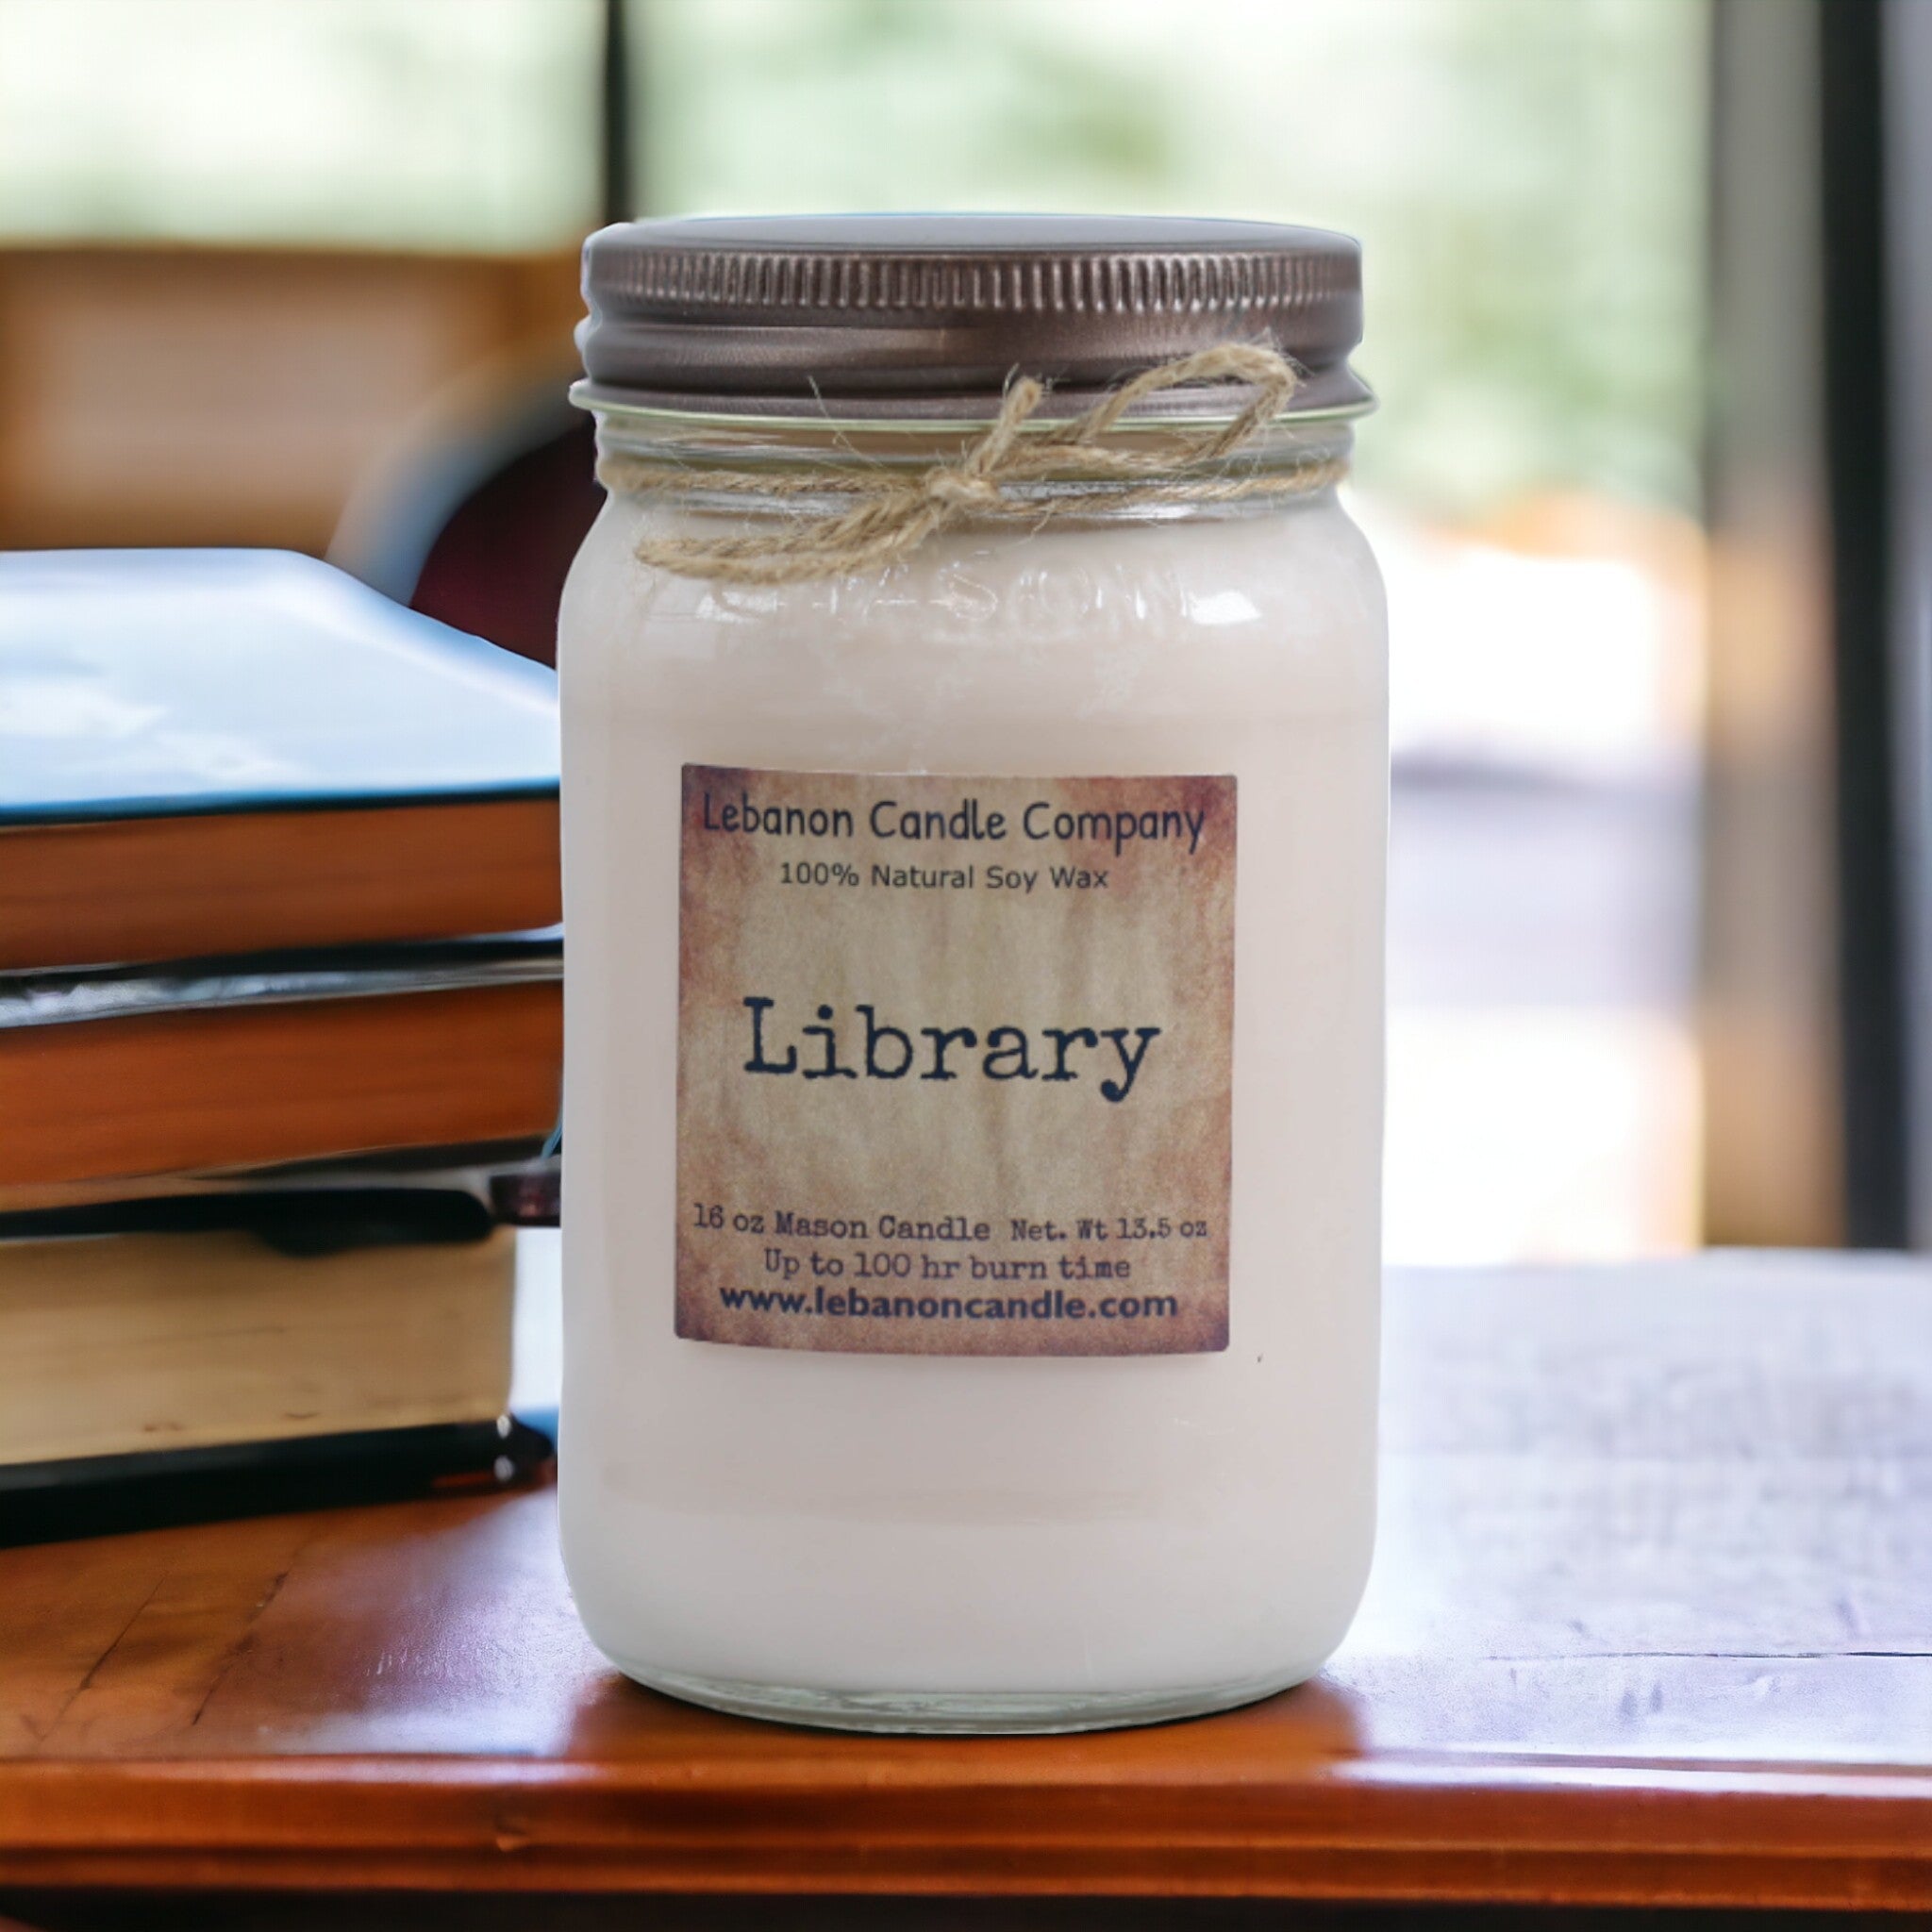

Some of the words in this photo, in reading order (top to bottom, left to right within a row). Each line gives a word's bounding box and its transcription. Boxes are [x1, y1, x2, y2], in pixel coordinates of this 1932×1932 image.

[704, 792, 853, 837] Lebanon
[868, 799, 1007, 841] Candle
[1023, 801, 1205, 856] Company
[780, 861, 859, 887] 100%
[872, 864, 974, 890] Natural
[986, 866, 1038, 894] Soy
[1050, 866, 1108, 889] Wax
[742, 996, 1161, 1104] Library
[693, 1203, 724, 1230] 16
[733, 1213, 765, 1235] oz
[774, 1211, 868, 1240] Mason
[877, 1214, 991, 1241] Candle
[1010, 1219, 1068, 1241] Net.
[1076, 1219, 1108, 1241] Wt
[1117, 1217, 1172, 1241] 13.5
[1179, 1221, 1208, 1239] oz
[763, 1247, 801, 1279] Up
[809, 1251, 844, 1277] to
[854, 1252, 911, 1278] 100
[920, 1254, 961, 1279] hr
[969, 1255, 1048, 1280] burn
[1057, 1255, 1131, 1280] time
[720, 1286, 1177, 1320] www.lebanoncandle.com
